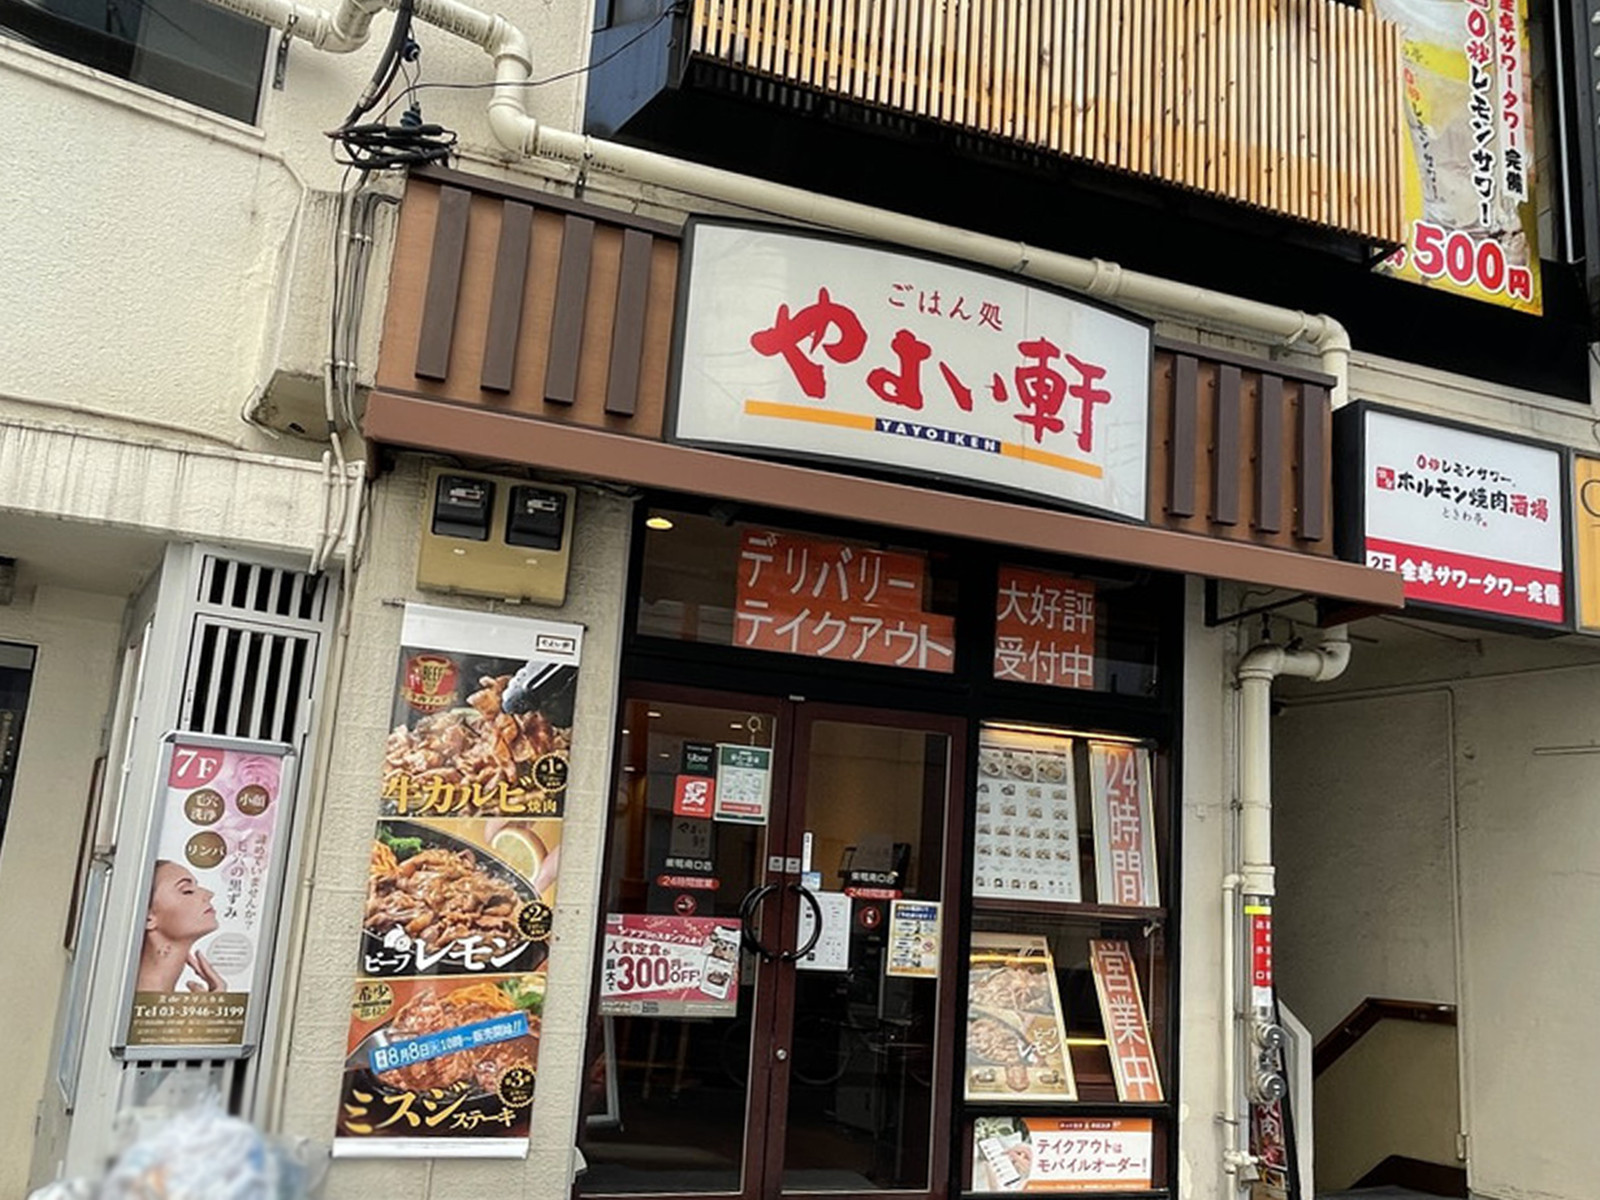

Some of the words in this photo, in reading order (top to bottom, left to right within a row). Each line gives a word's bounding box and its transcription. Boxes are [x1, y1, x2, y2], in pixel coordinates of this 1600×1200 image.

[888, 283, 1003, 331] ごはん処
[750, 287, 1111, 452] やよい軒
[880, 420, 998, 451] YAYOIKEN
[1397, 472, 1550, 522] ホルモン焼肉酒場
[742, 532, 915, 602] デリバリー
[998, 580, 1094, 634] 大好評
[736, 600, 953, 670] テイクアウト
[995, 635, 1094, 688] 受付中
[174, 749, 217, 779] 7F
[1101, 943, 1153, 1100] 営業中
[1037, 1139, 1122, 1154] テイクアウトは
[1037, 1157, 1147, 1174] モバイルオーダー!
